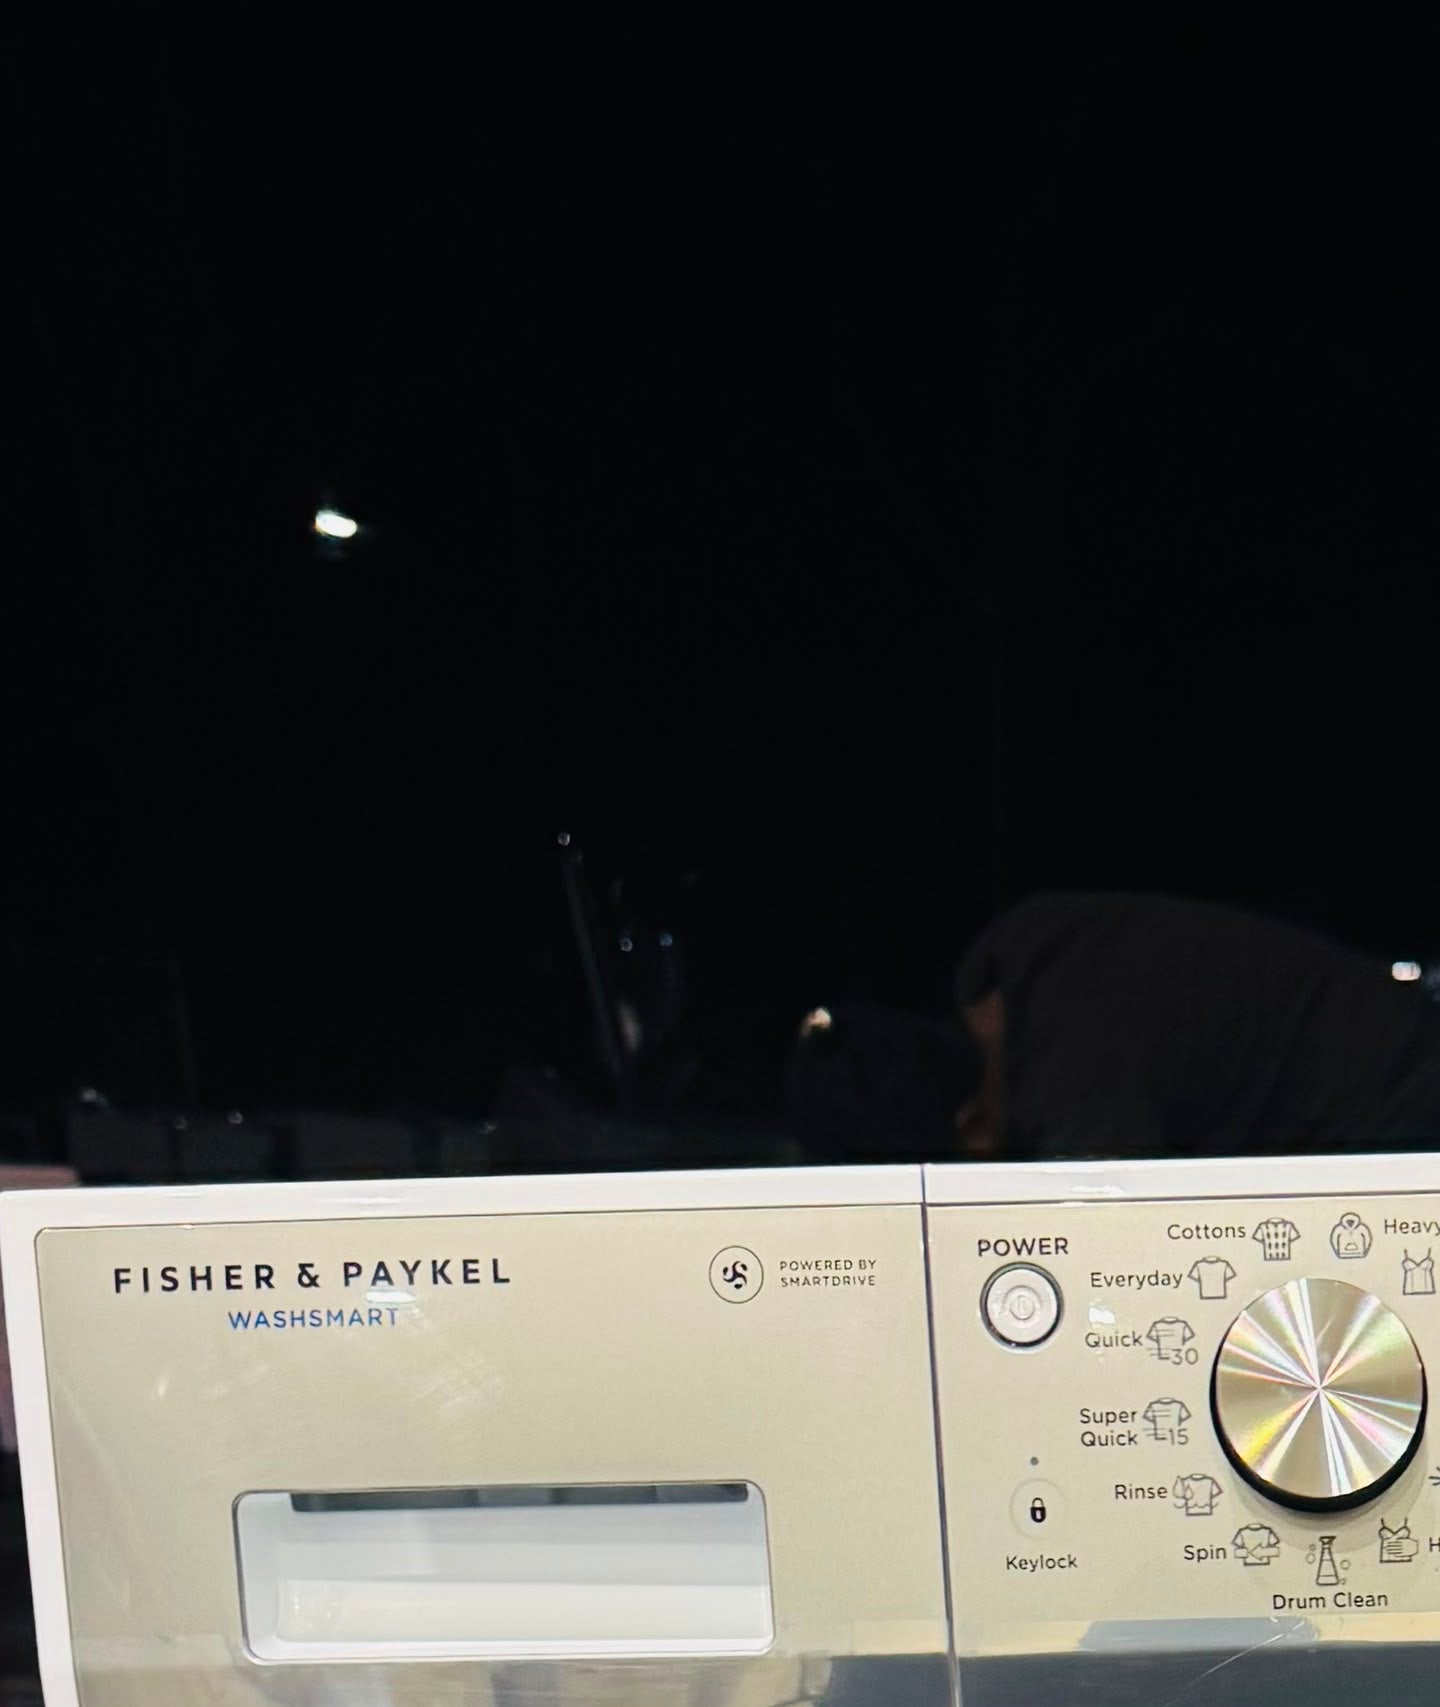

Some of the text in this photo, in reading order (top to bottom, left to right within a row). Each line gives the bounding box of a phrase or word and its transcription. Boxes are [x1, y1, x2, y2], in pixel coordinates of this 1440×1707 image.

[1168, 1224, 1246, 1239] Cottons
[978, 1238, 1068, 1256] POWER
[780, 1260, 876, 1271] POWERED BY
[114, 1259, 510, 1293] FISHER & PAYKEL
[781, 1275, 875, 1287] SMARTDRIVE
[1091, 1270, 1182, 1290] Everyday
[228, 1309, 397, 1329] WASHSMART
[1085, 1331, 1142, 1348] Quick
[1167, 1348, 1198, 1365] 30
[1080, 1408, 1137, 1426] Super
[1081, 1431, 1137, 1447] Quick
[1165, 1425, 1188, 1445] 15
[1115, 1485, 1167, 1499] Rinse
[1184, 1545, 1226, 1562] Spin
[1007, 1555, 1077, 1572] Keylock
[1273, 1592, 1387, 1609] Drum Clean
